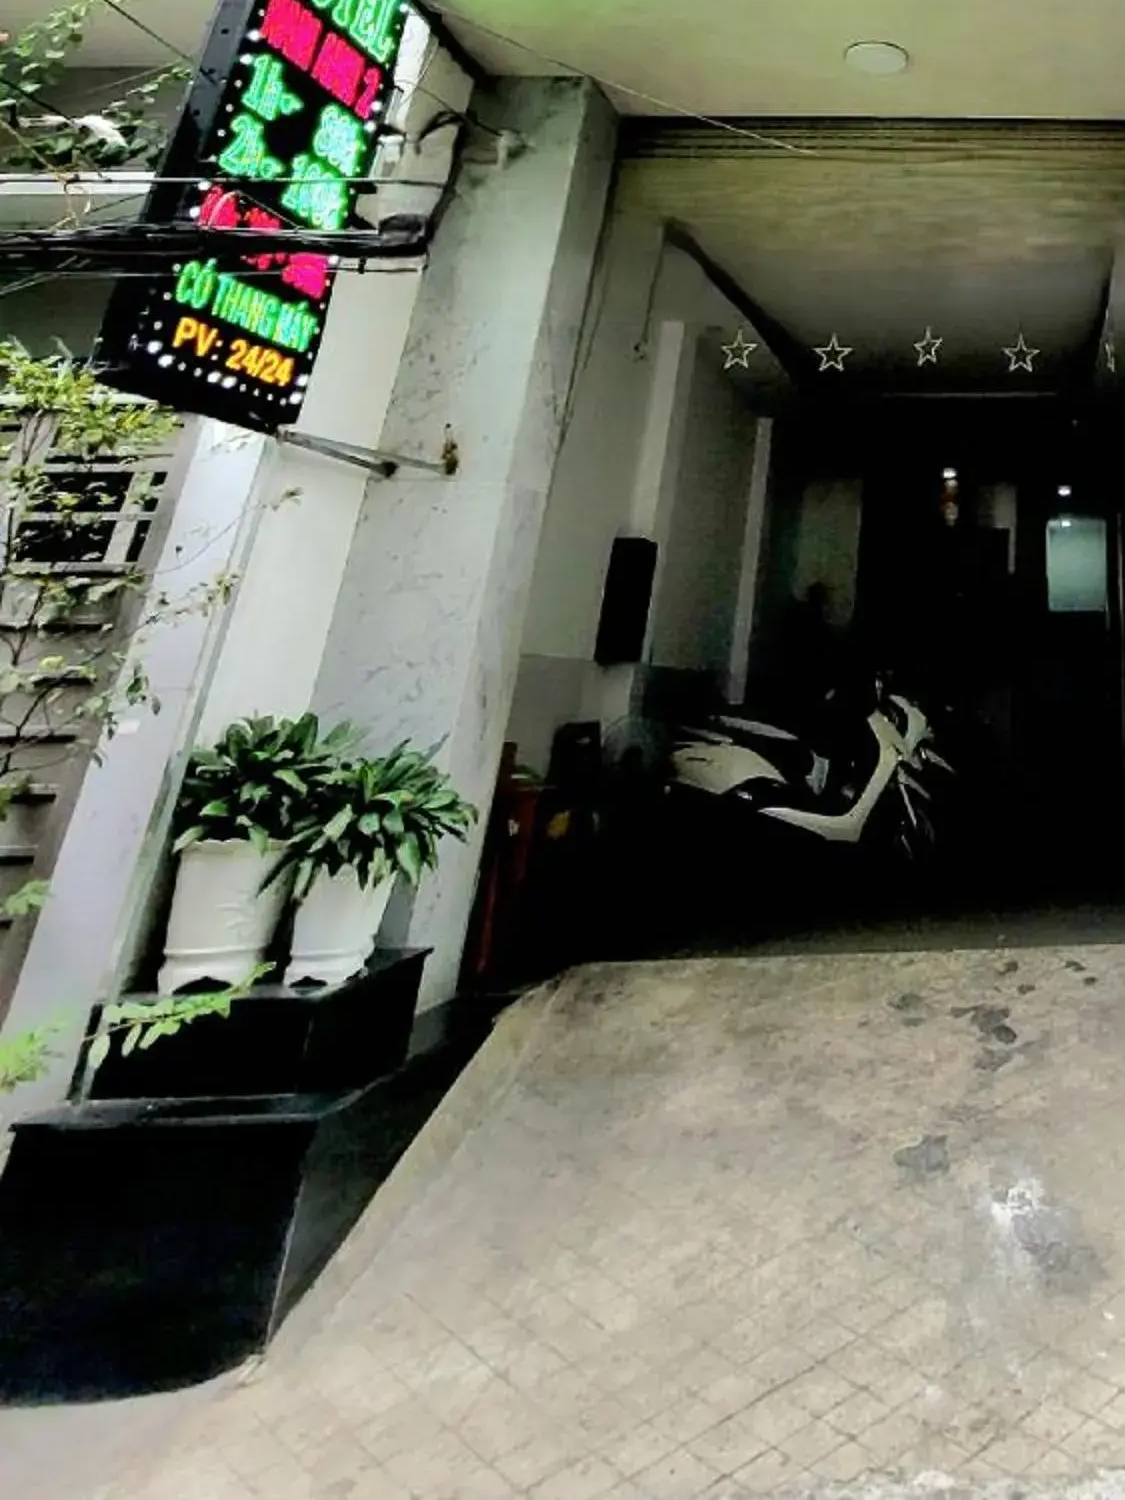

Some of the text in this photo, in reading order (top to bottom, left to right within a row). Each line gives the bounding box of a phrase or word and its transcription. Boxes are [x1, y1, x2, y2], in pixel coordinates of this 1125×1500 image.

[354, 67, 381, 119] 2
[175, 257, 217, 309] CÓ
[211, 272, 278, 339] THANG
[225, 339, 295, 386] 24/24
